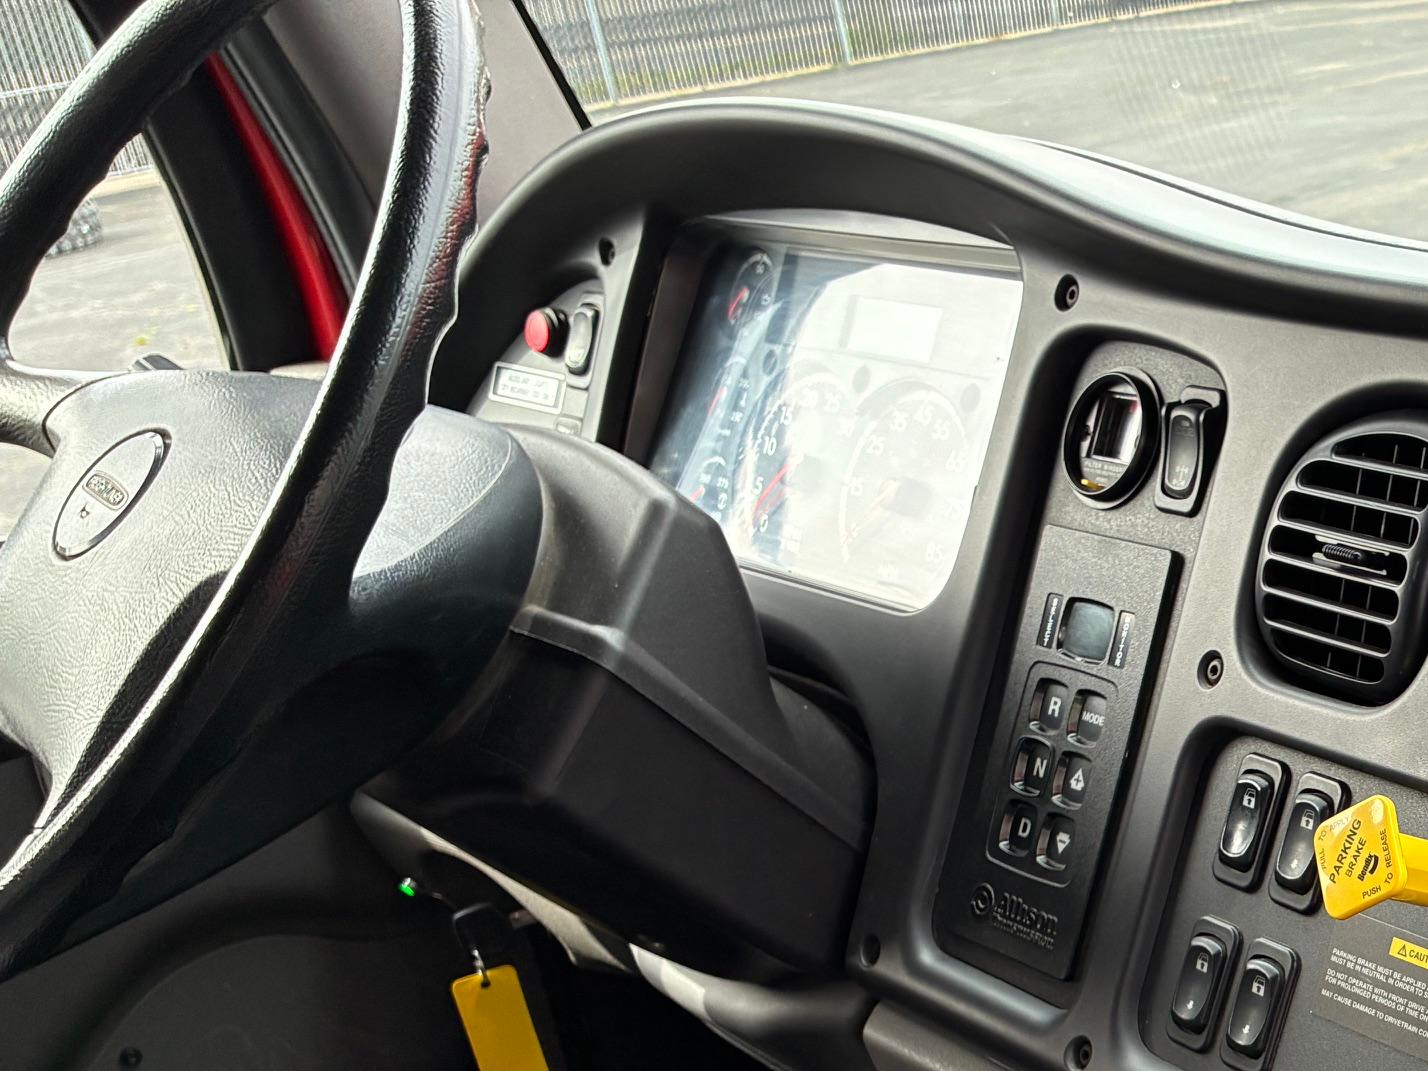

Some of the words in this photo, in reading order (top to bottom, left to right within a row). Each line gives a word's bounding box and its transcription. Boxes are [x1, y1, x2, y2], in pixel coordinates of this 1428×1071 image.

[780, 407, 792, 424] 15
[763, 436, 777, 456] 10
[867, 437, 885, 456] 25
[754, 477, 764, 495] 5
[759, 514, 769, 533] 0
[1114, 616, 1131, 667] MONITOR
[1047, 696, 1062, 718] R
[1082, 711, 1105, 727] MODE
[1033, 757, 1047, 779] N
[1018, 818, 1032, 838] D
[1318, 829, 1327, 842] TO
[1329, 818, 1362, 884] PARKING
[1345, 837, 1367, 878] BRAKE
[1379, 828, 1393, 868] RELEASE
[1357, 852, 1375, 882] Bendix
[1384, 872, 1394, 884] TO
[1362, 885, 1382, 899] PUSH
[1331, 955, 1346, 965] MUST
[1346, 961, 1354, 969] BE
[1355, 964, 1361, 972] IN
[1362, 966, 1387, 982] NEUTRAL
[1388, 977, 1394, 985] IN
[1394, 980, 1415, 993] ORDER
[1415, 988, 1424, 997] TO
[1333, 948, 1356, 962] PARKING
[1357, 957, 1376, 970] BRAKE
[1377, 965, 1393, 976] MUST
[1393, 971, 1402, 979] BE
[1402, 976, 1426, 990] APPLIED
[1325, 975, 1337, 985] FOR
[1337, 980, 1371, 999] PROLONGED
[1371, 994, 1396, 1009] PERIODS
[1396, 1004, 1405, 1012] OF
[1405, 1007, 1419, 1018] TIME
[1419, 1013, 1428, 1023] ON
[1327, 968, 1336, 977] DO
[1336, 972, 1348, 981] NOT
[1348, 976, 1373, 992] OPERATE
[1374, 985, 1388, 997] WITH
[1388, 992, 1408, 1005] FRONT
[1408, 1001, 1425, 1013] DRIVE
[1321, 988, 1333, 998] MAY
[1333, 993, 1352, 1007] CAUSE
[1352, 1001, 1376, 1017] DAMAGE
[1376, 1011, 1384, 1019] TO
[1384, 1014, 1418, 1033] DRIVETRAIN
